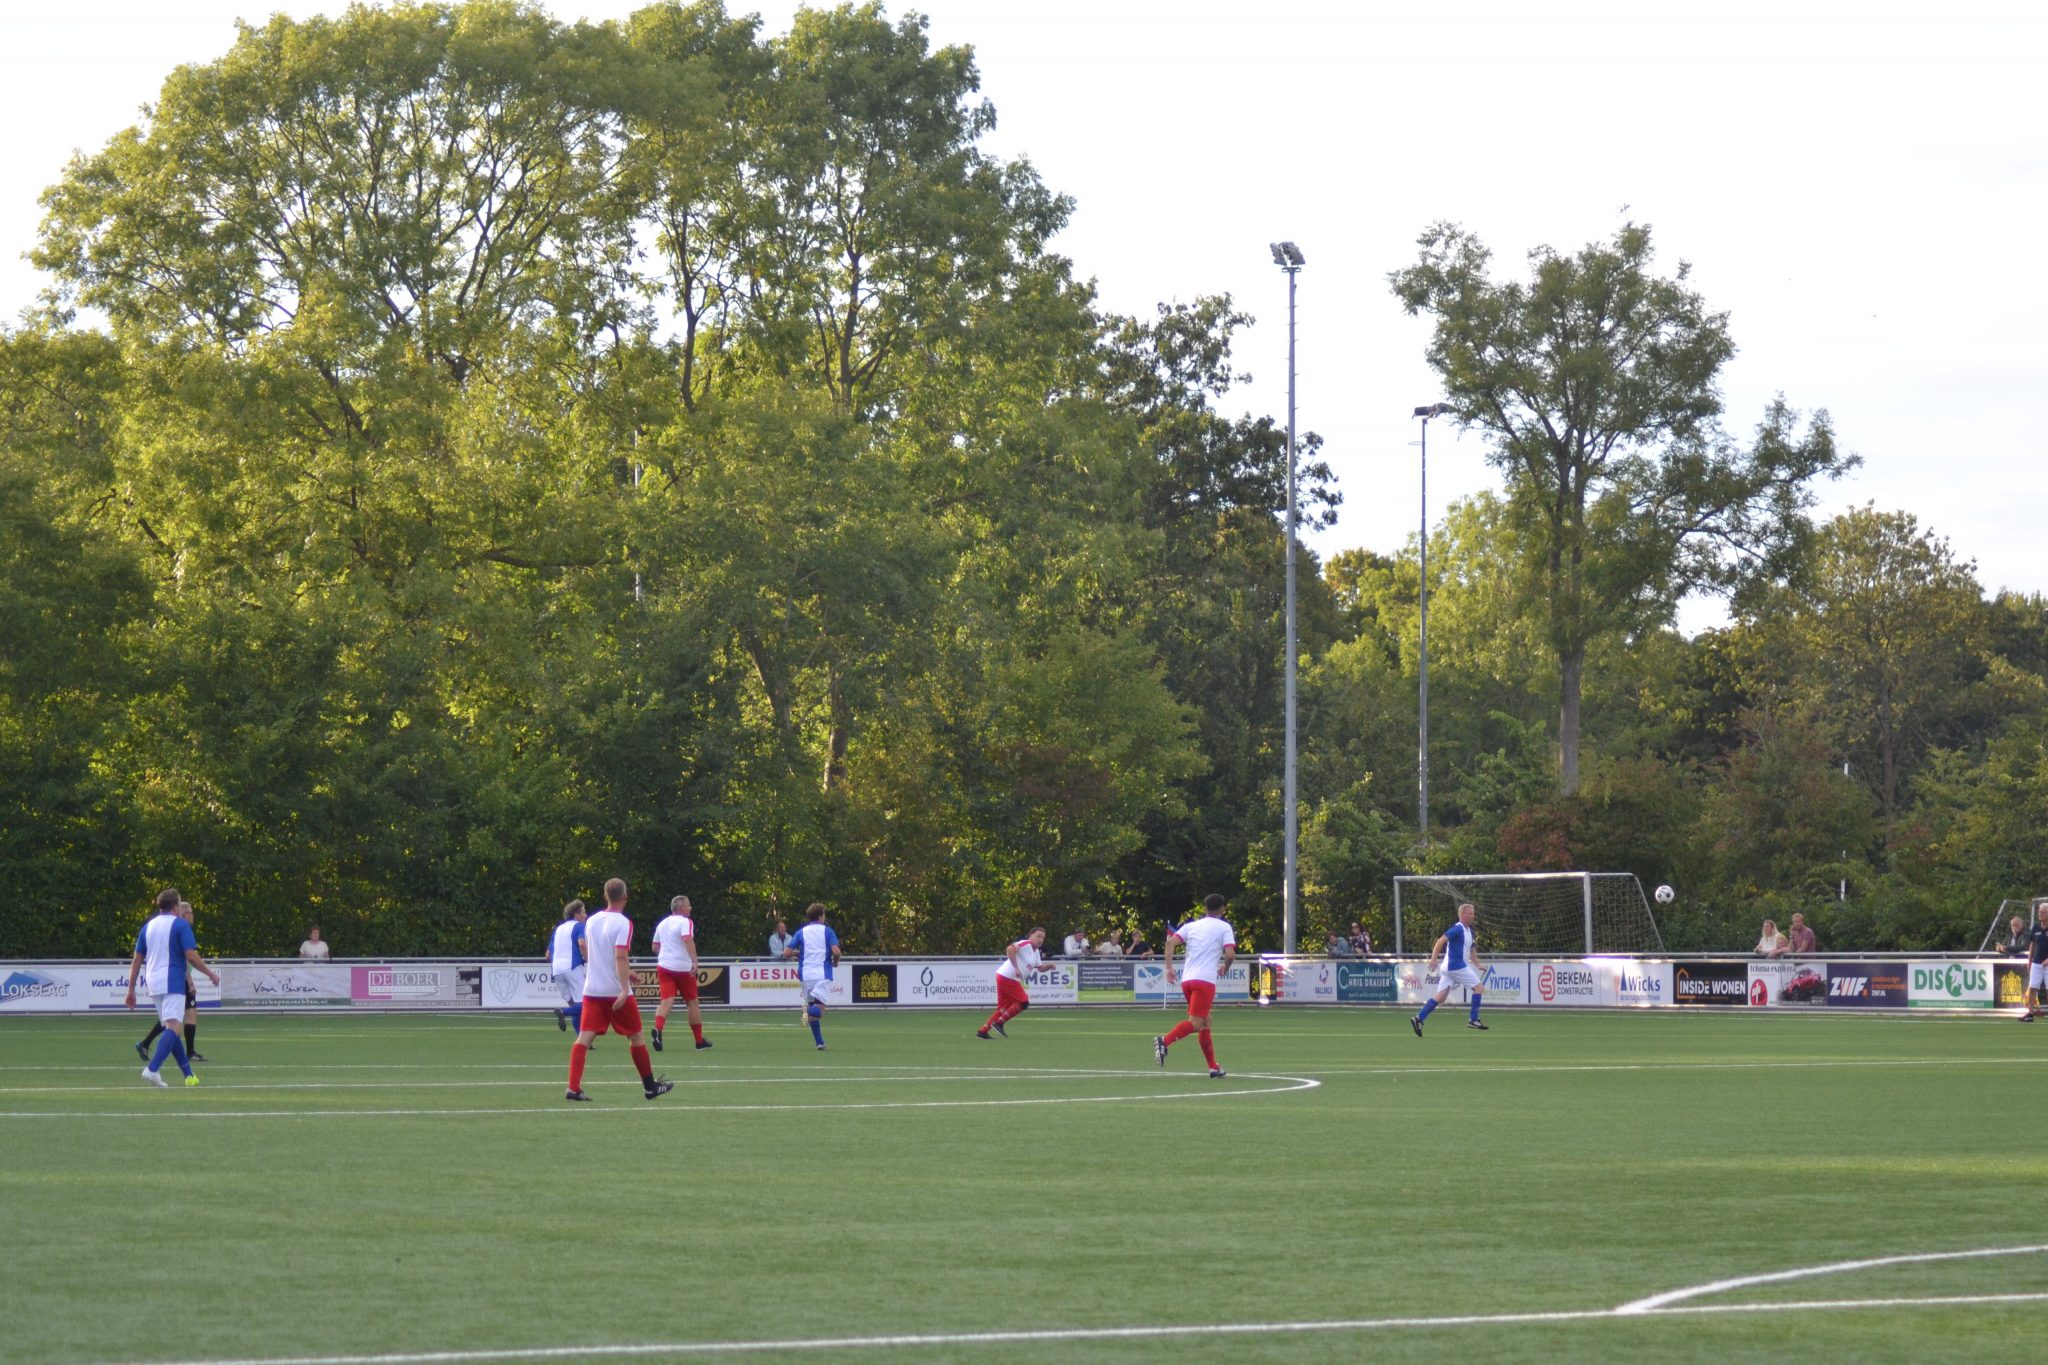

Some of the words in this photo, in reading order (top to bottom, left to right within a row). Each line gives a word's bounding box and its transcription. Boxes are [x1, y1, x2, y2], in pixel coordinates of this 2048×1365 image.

[371, 973, 391, 985] DE
[396, 973, 434, 985] BOER
[739, 968, 799, 980] GIESIN
[1556, 972, 1593, 985] BEKEMA
[1490, 977, 1520, 990] YNTEMA
[1627, 975, 1662, 992] Wicks
[1914, 964, 1987, 997] DISCUS
[253, 981, 278, 993] Van
[282, 983, 318, 993] Buren
[930, 986, 997, 996] GROENVOORZIENE
[1556, 986, 1594, 996] CONSTRUCTIE
[1680, 980, 1711, 995] INSIDE
[1712, 980, 1747, 995] WONEN
